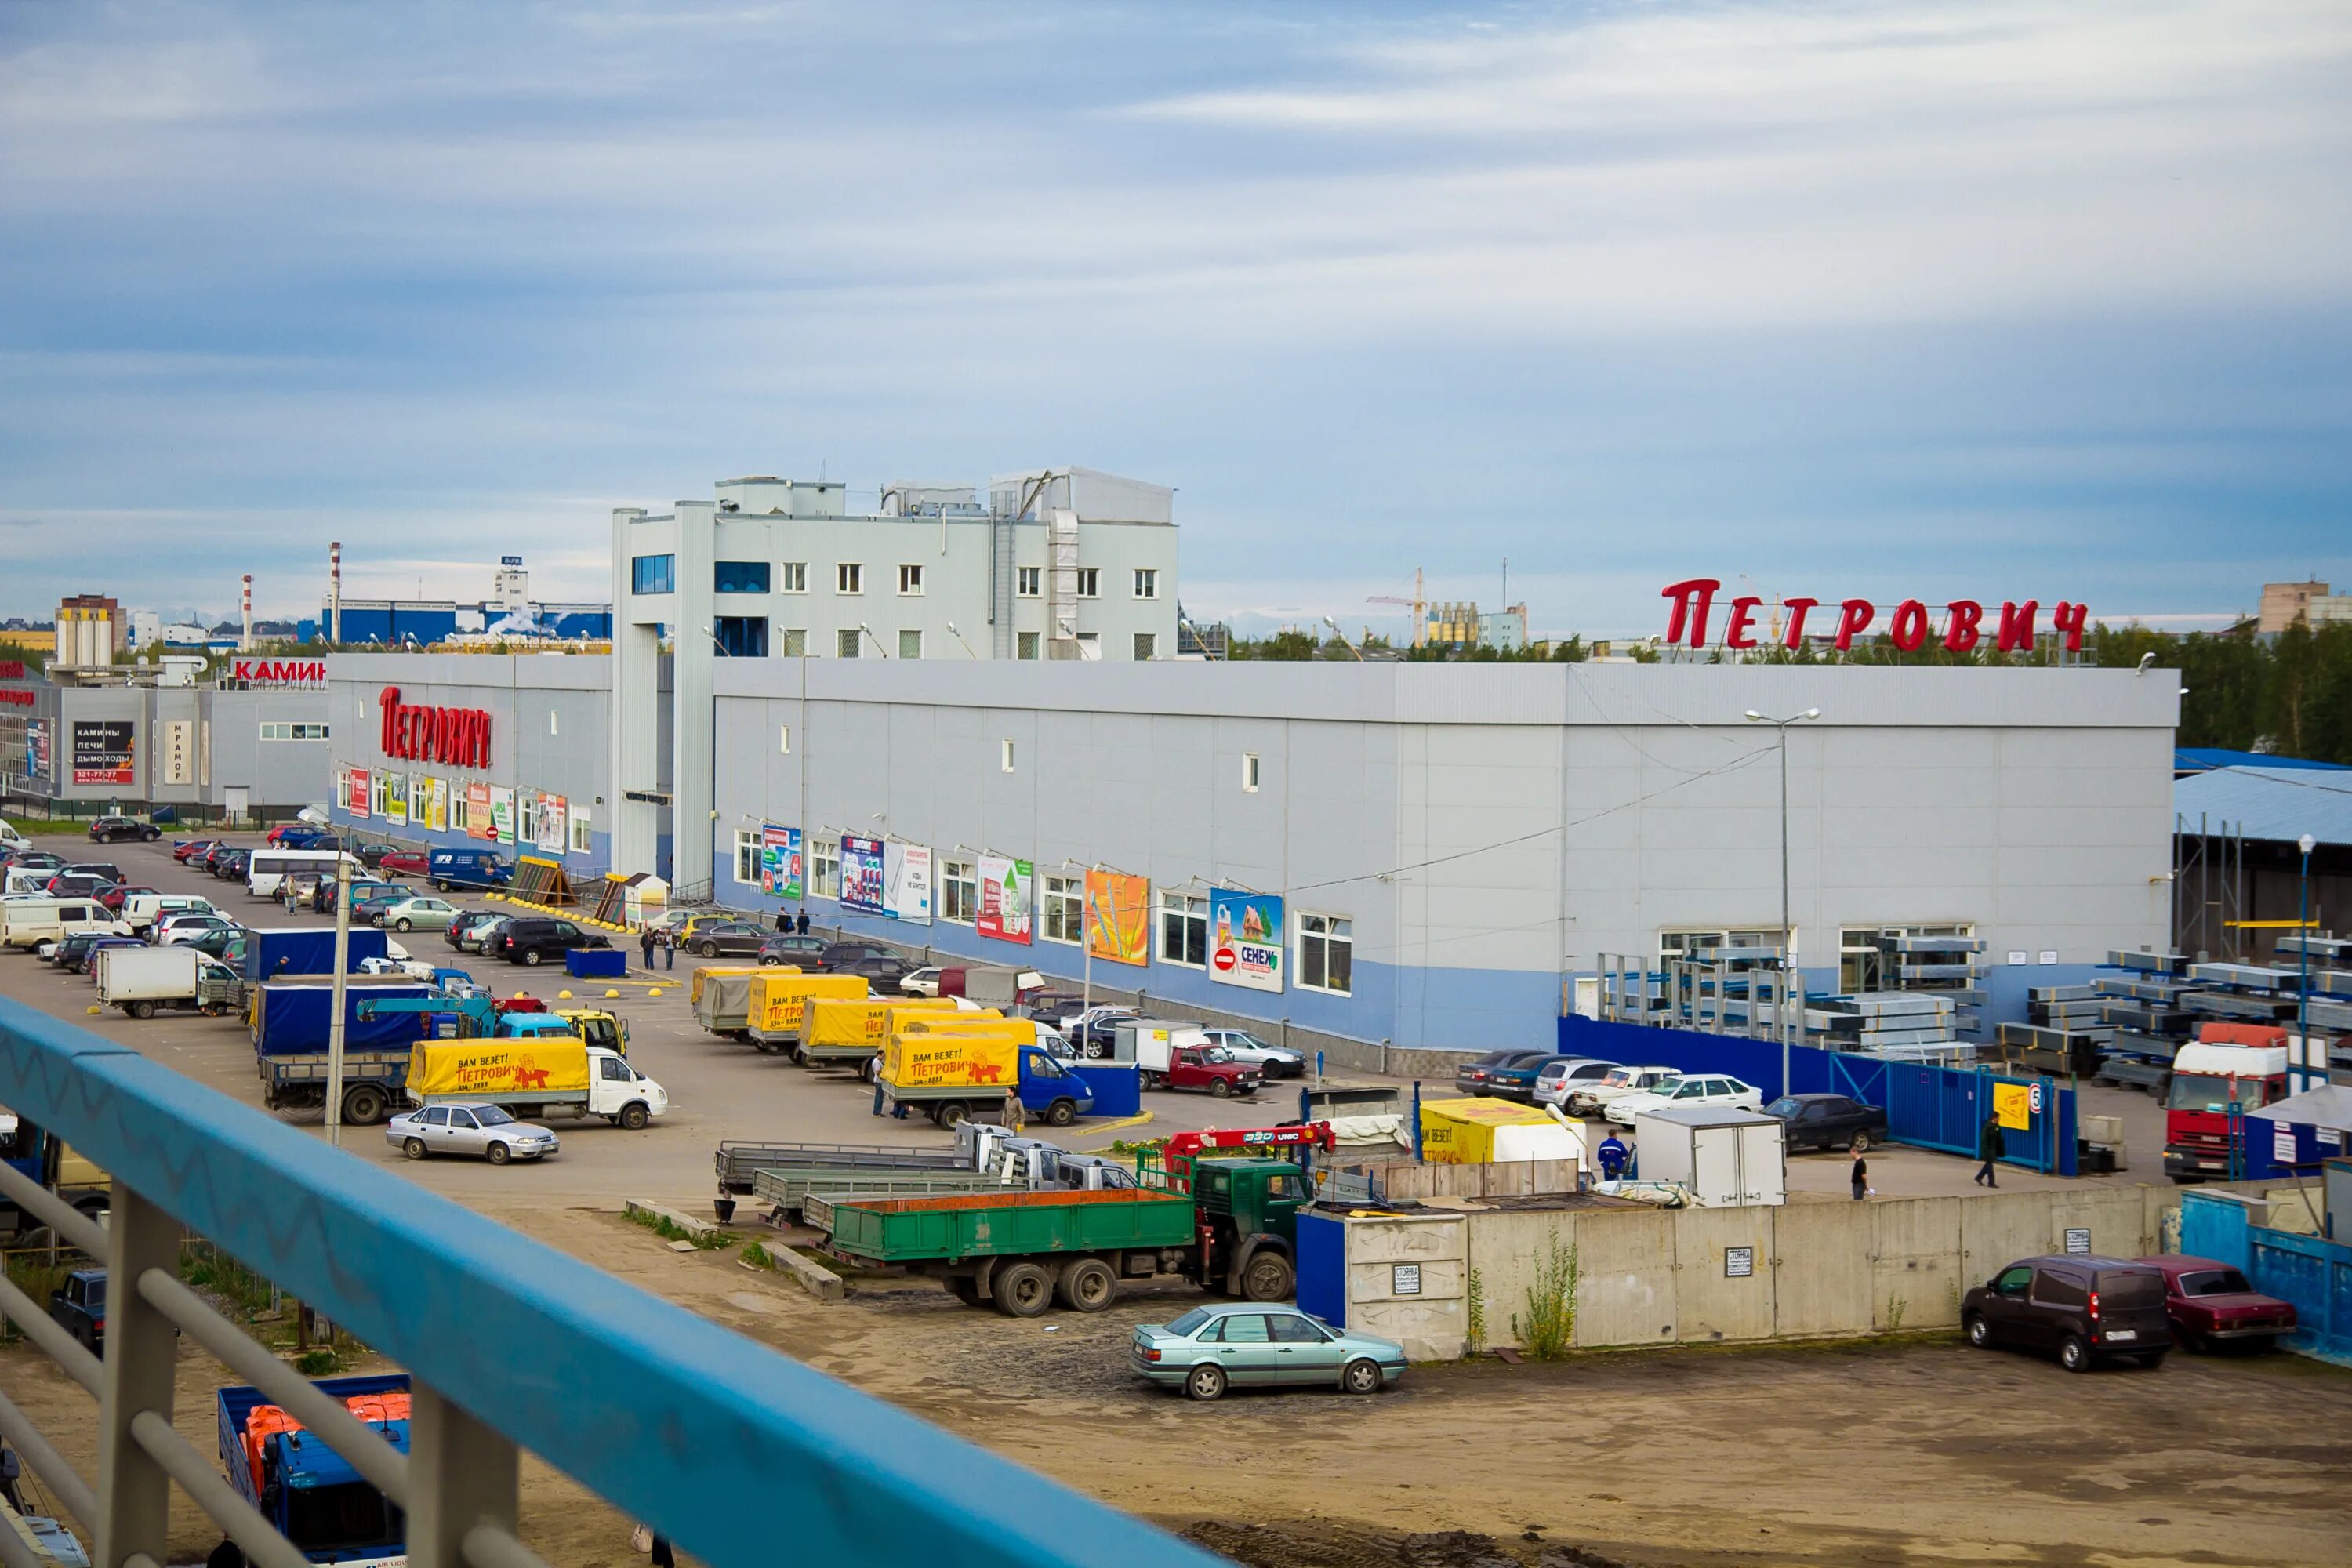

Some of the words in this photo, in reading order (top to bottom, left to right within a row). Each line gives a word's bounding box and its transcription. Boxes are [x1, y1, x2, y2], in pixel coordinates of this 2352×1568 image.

[1661, 579, 2088, 653] ПЕТРОВИЧ
[379, 686, 489, 769] ПЕТРОВИЧ
[772, 996, 788, 1006] ВАМ
[458, 1058, 476, 1068] ВАМ
[913, 1053, 931, 1062] ВАМ
[456, 1065, 519, 1083] ПЕТРОВИЧ
[910, 1060, 972, 1076] ПЕТРОВИЧ
[2034, 1091, 2040, 1106] 5
